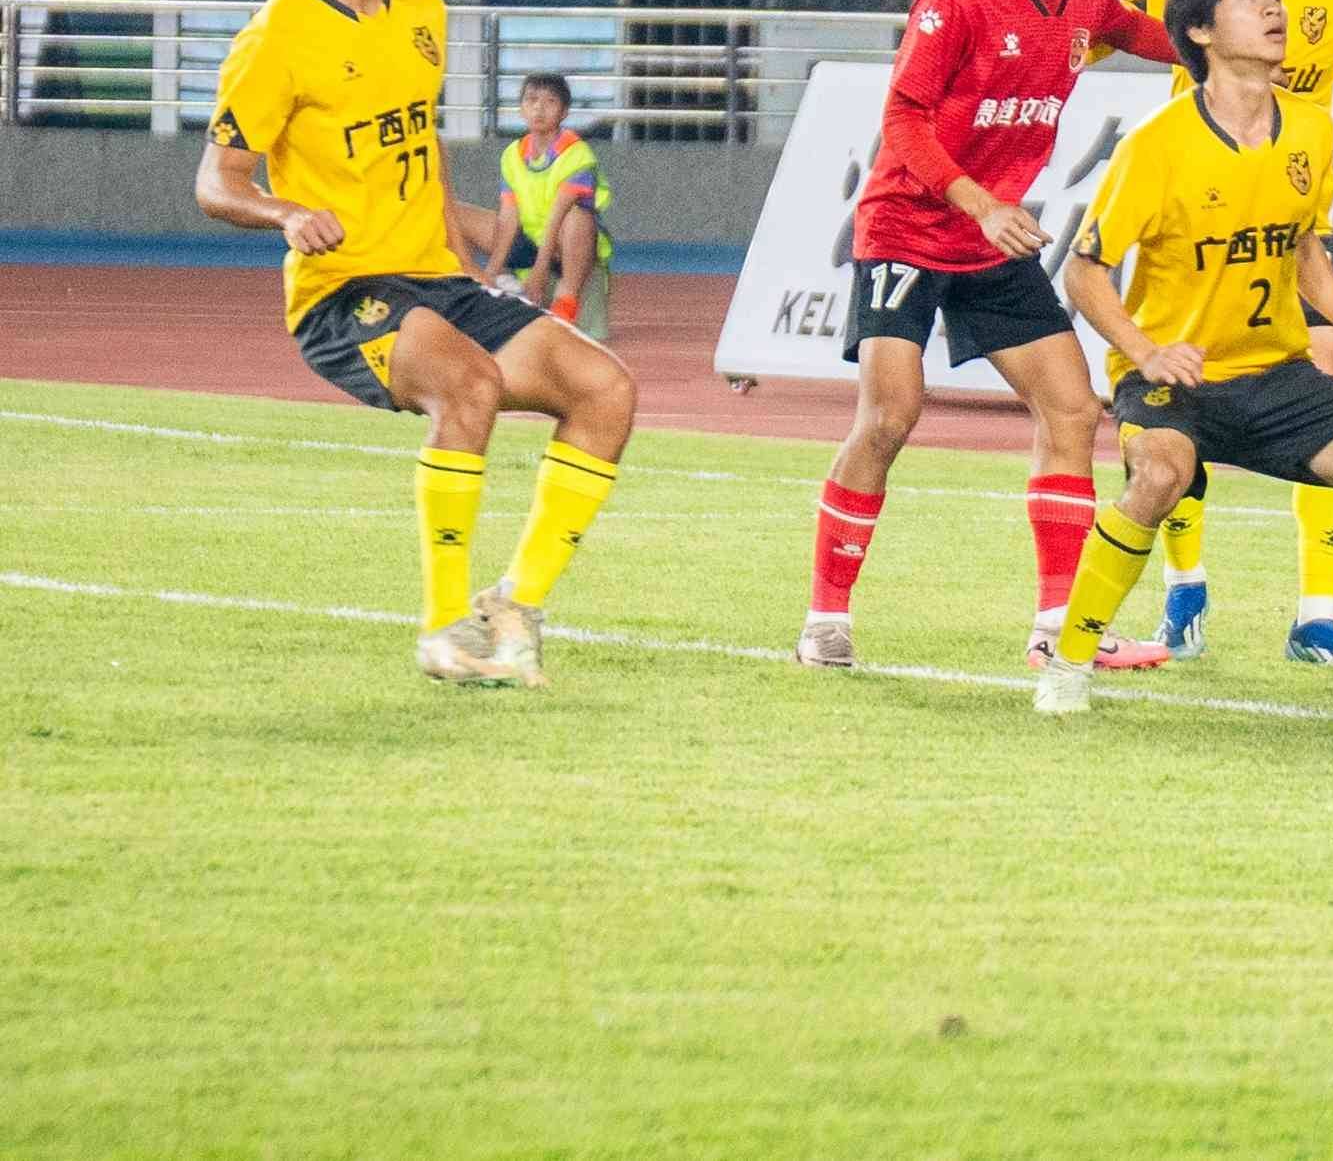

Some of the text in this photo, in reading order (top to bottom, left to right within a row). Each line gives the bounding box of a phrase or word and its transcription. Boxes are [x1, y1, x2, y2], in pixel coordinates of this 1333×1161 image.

[343, 99, 436, 159] 广西布
[870, 261, 921, 311] 17
[1247, 278, 1272, 327] 2
[772, 289, 847, 338] KEL
